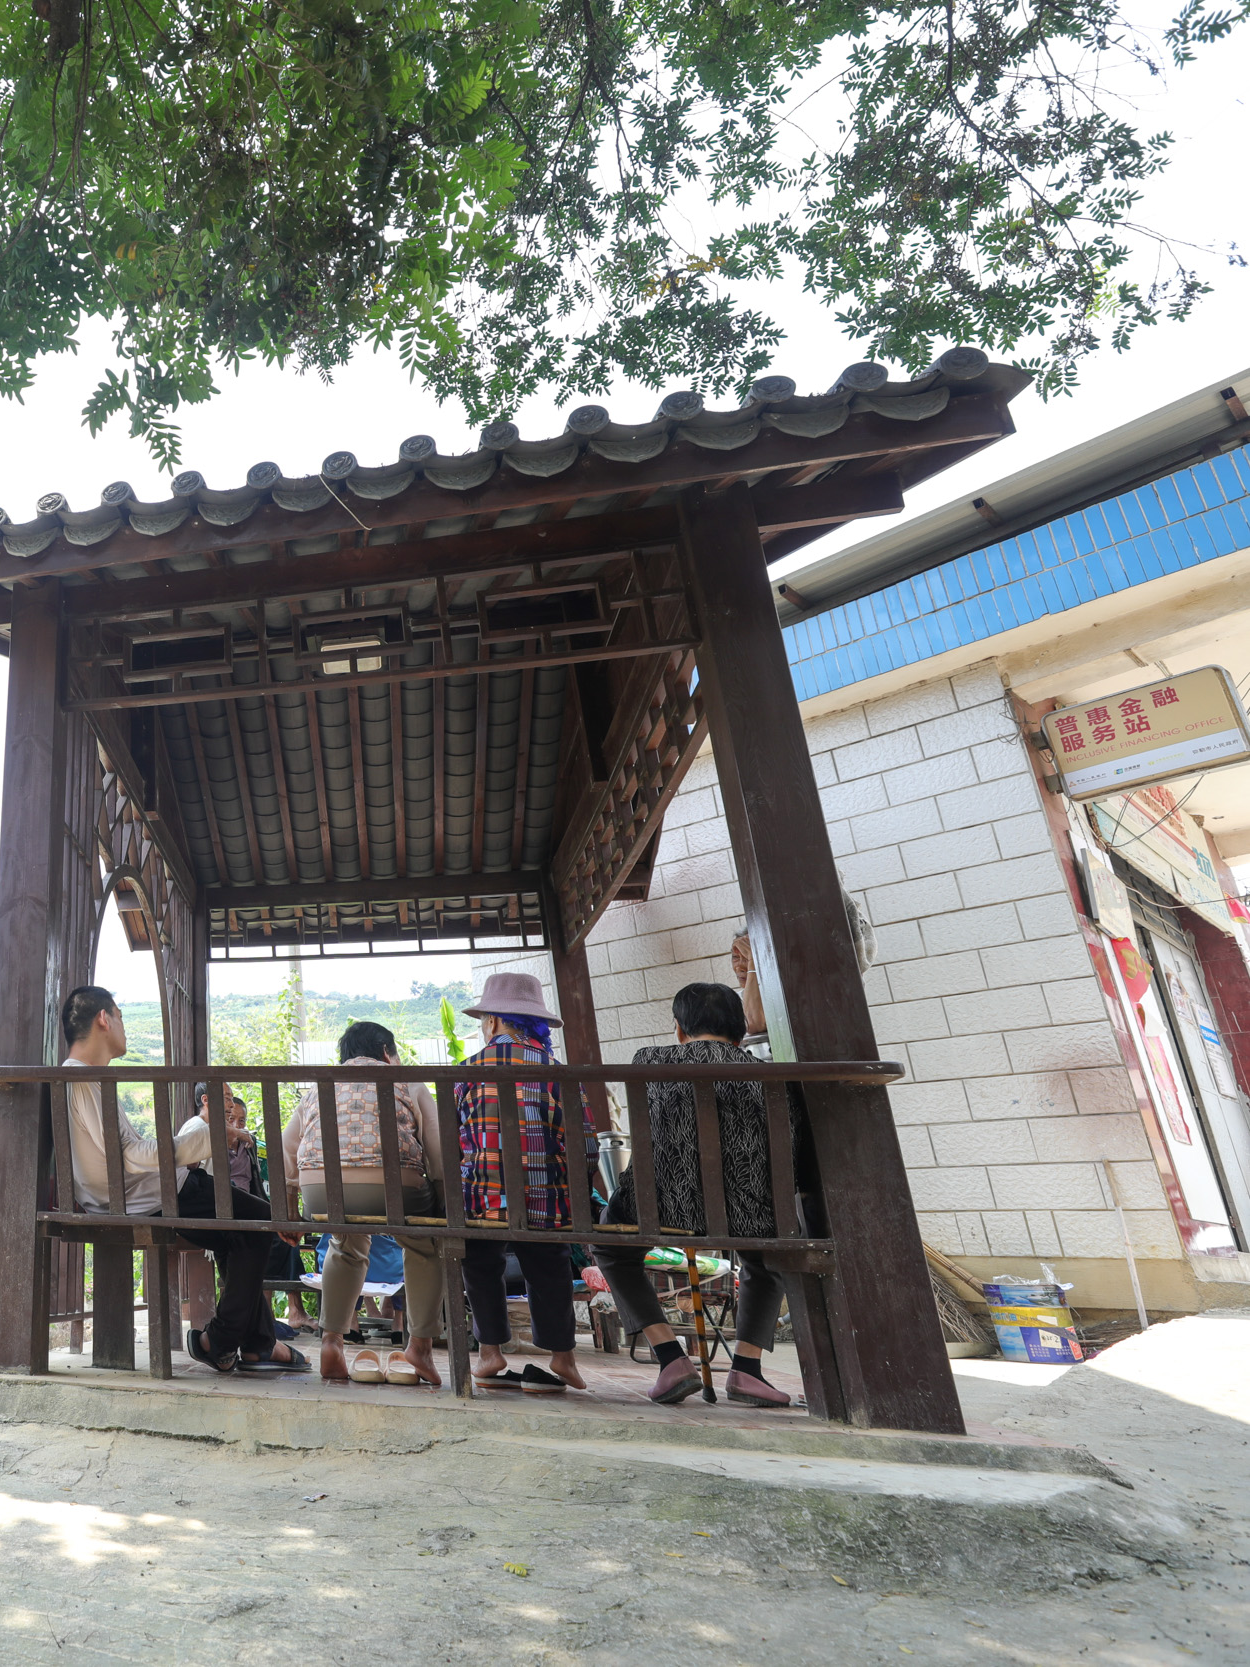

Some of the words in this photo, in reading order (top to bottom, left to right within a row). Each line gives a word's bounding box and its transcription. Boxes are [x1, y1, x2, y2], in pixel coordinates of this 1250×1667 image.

[1054, 687, 1181, 735] 普惠金融
[1060, 714, 1152, 753] 服务站
[1066, 745, 1116, 763] INCLUSIVE
[1120, 728, 1181, 749] FINANCING
[1185, 716, 1225, 731] OFFICE
